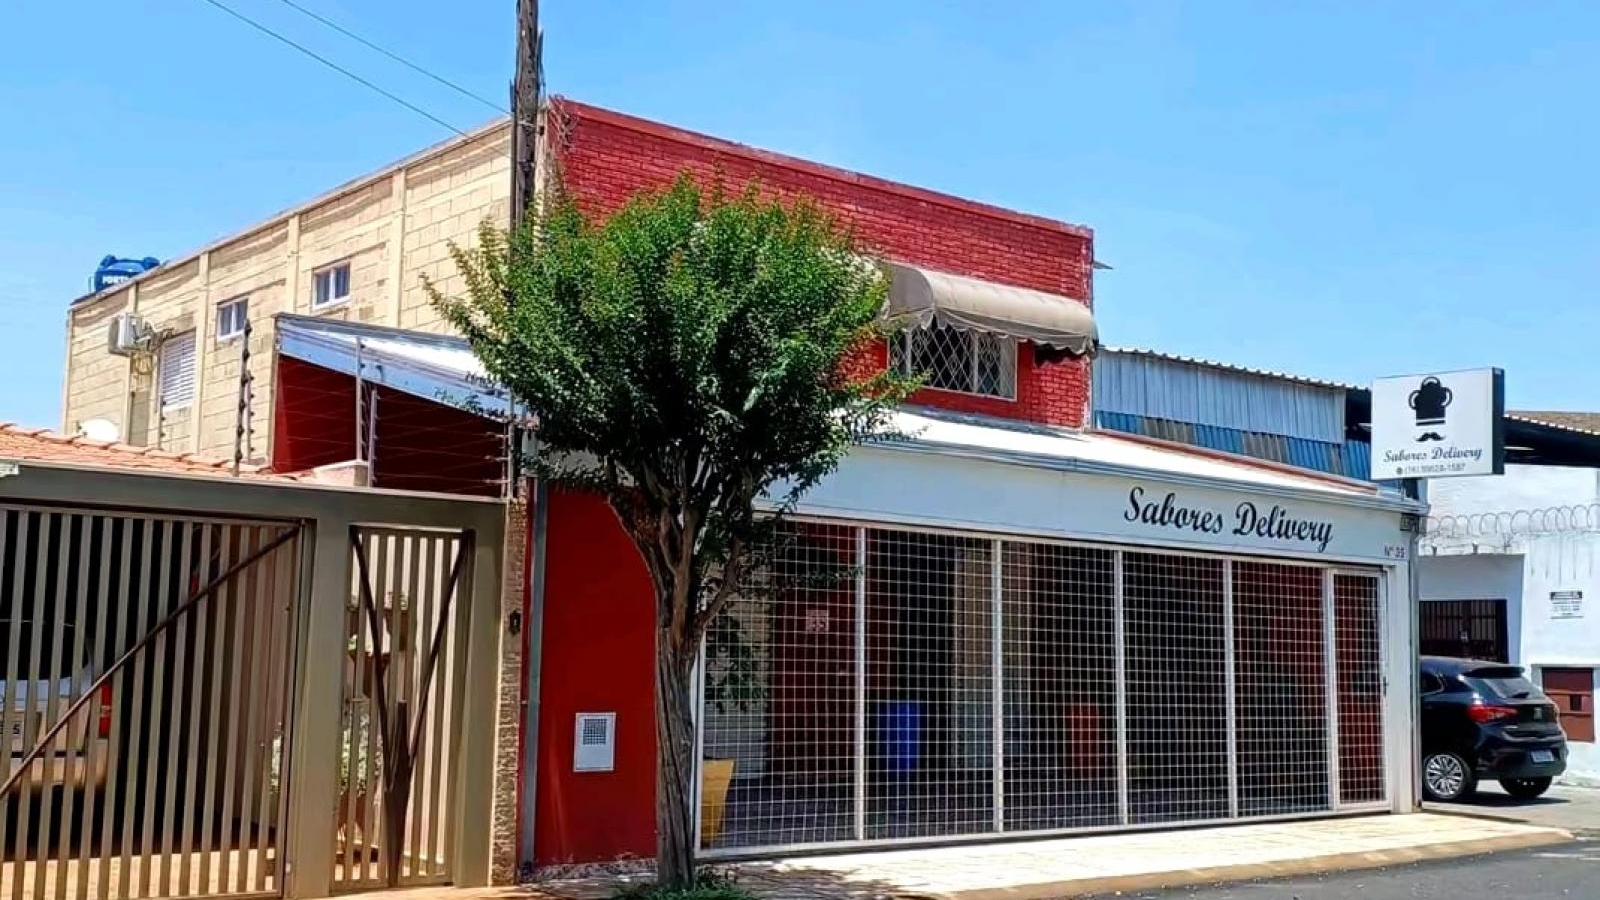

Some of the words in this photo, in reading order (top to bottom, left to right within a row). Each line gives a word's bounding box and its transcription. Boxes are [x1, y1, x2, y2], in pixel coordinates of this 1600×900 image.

[1384, 449, 1427, 462] Sabores
[1433, 447, 1482, 461] Delivery
[1124, 487, 1223, 535] Sabores
[1234, 501, 1333, 552] Delivery
